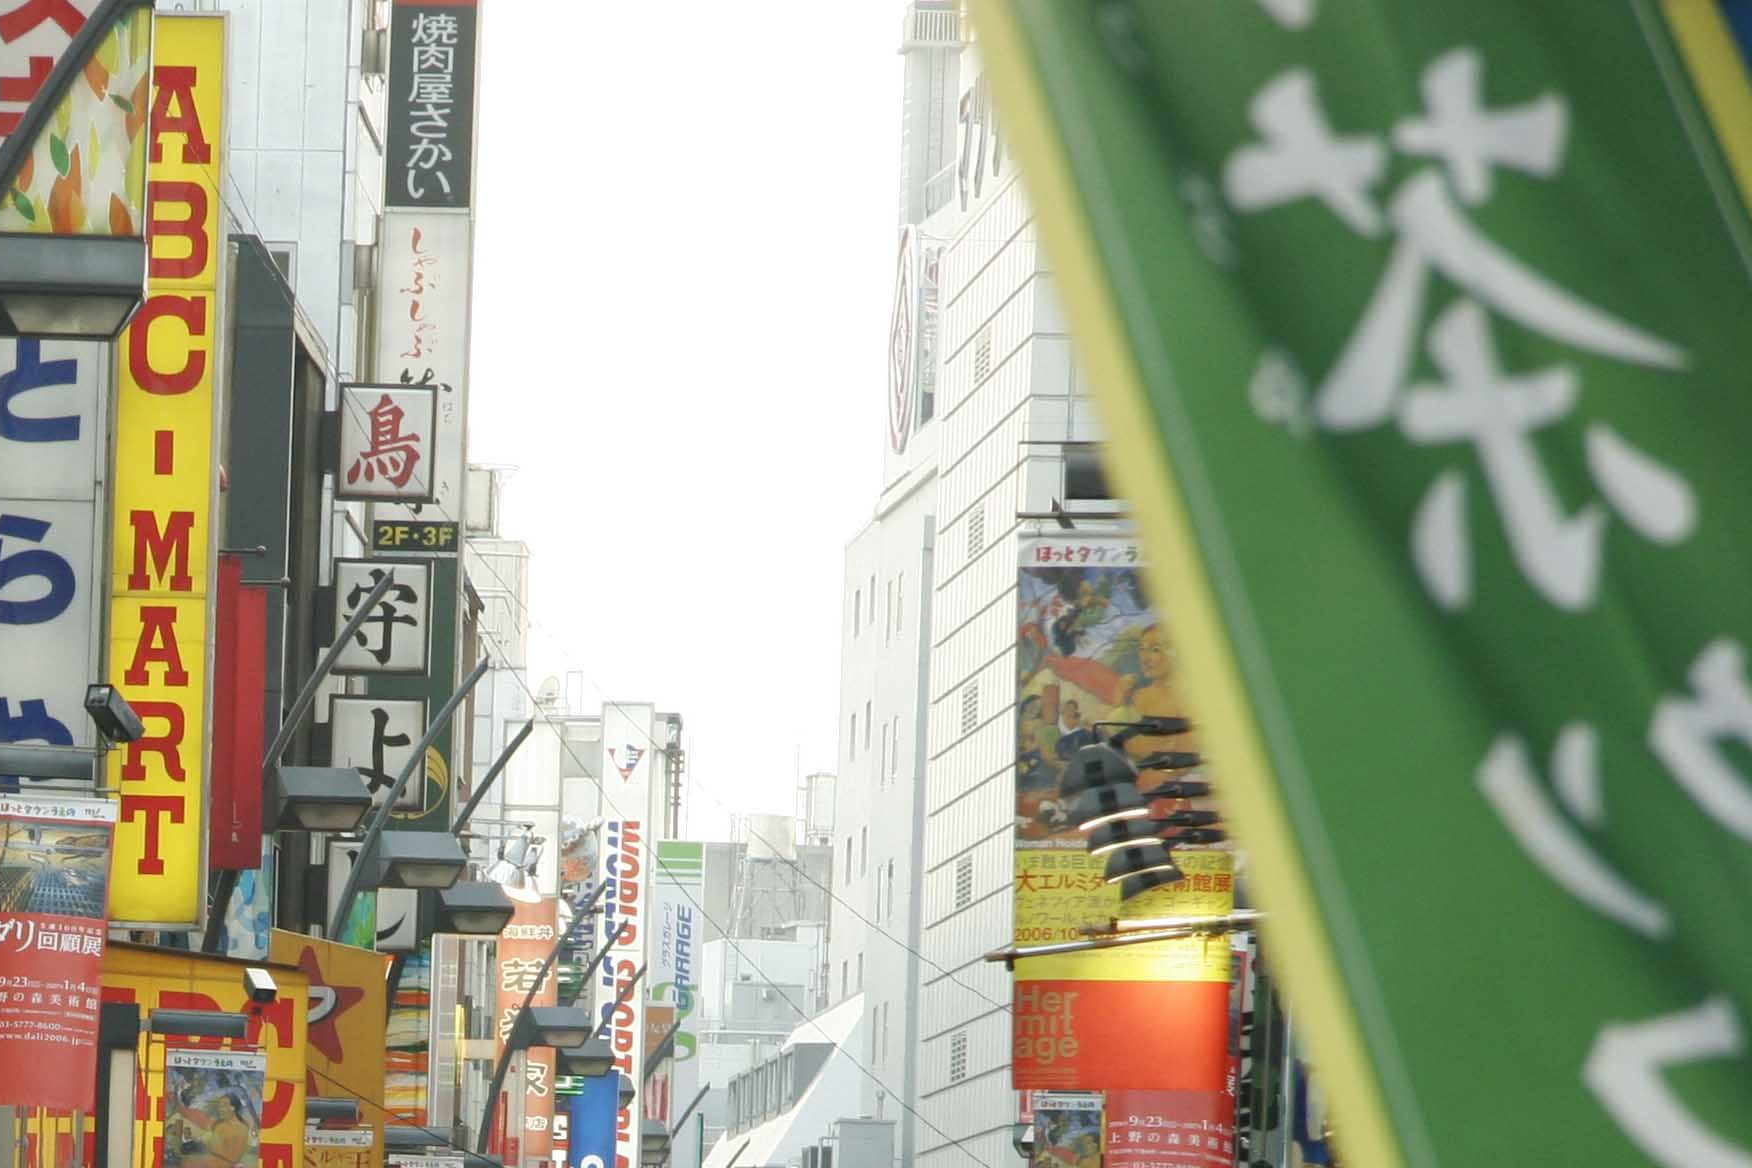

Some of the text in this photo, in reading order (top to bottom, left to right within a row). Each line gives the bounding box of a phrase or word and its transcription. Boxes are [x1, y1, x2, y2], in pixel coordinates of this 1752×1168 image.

[405, 12, 459, 200] 焼肉屋さかい
[118, 65, 212, 876] ABC-MART
[604, 820, 641, 946] WORLD
[671, 903, 693, 1011] GARAGE
[1014, 985, 1080, 1012] Her
[1014, 1009, 1075, 1036] mit
[1014, 1035, 1080, 1065] age
